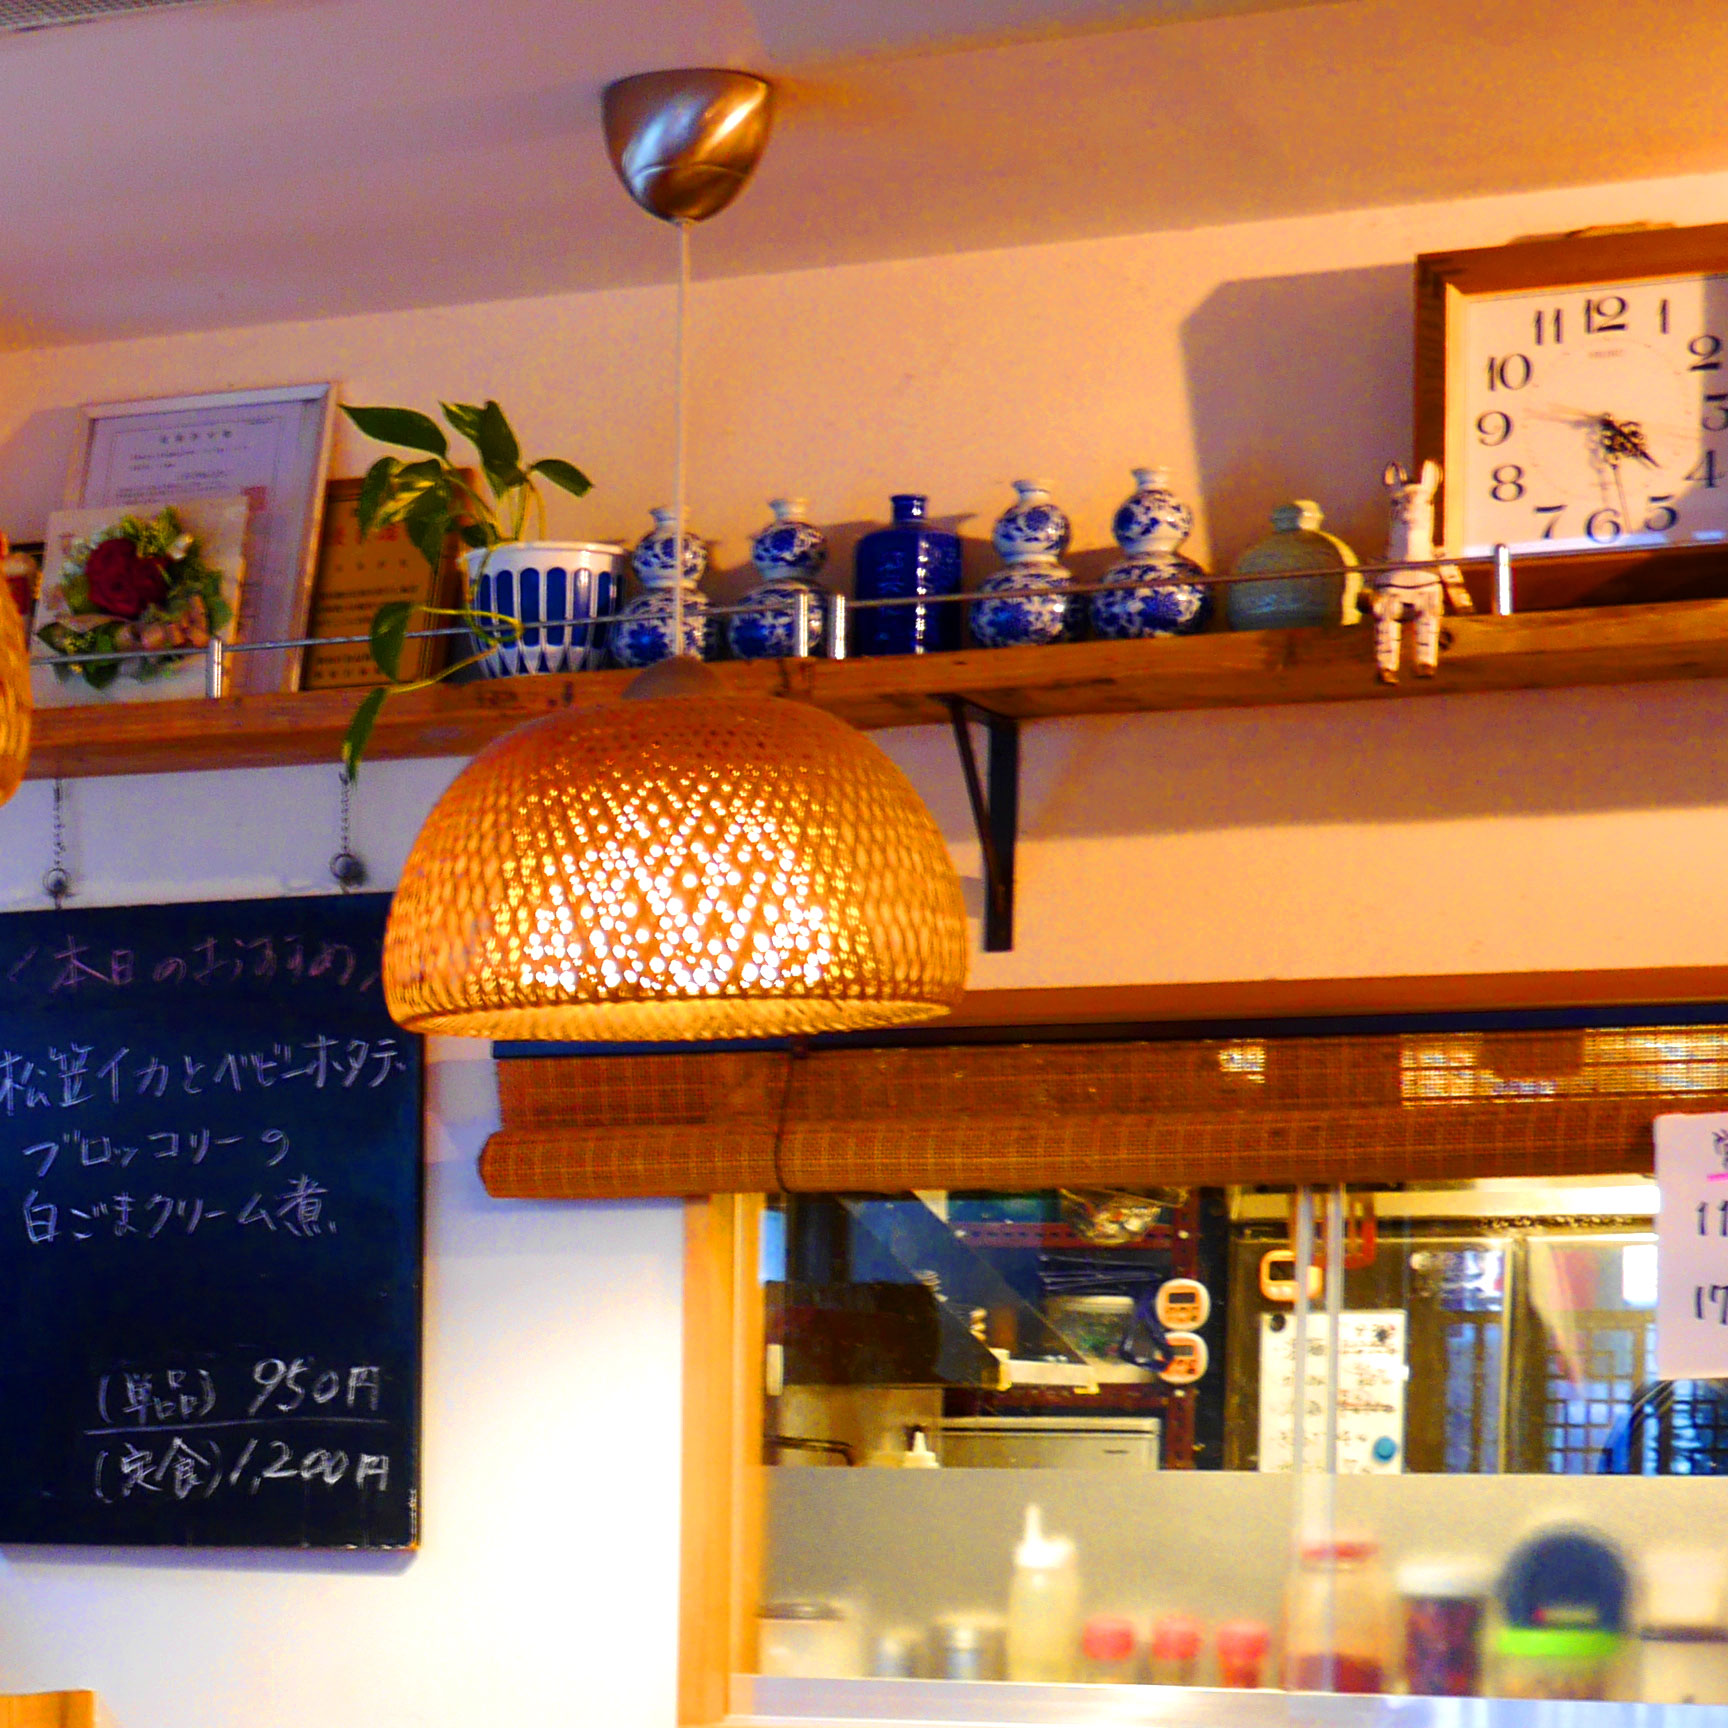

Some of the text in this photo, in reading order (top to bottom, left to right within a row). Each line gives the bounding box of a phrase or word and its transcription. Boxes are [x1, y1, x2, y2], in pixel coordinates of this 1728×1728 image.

[1534, 308, 1564, 346] 11
[1584, 296, 1628, 335] 12
[1659, 299, 1670, 335] 1
[1487, 352, 1532, 392] 10
[1687, 334, 1722, 372] 2
[1477, 411, 1512, 447] 9
[1702, 393, 1728, 432] 3
[1491, 464, 1526, 502] 8
[1685, 449, 1724, 489] 4
[1534, 505, 1568, 540] 7
[1585, 508, 1621, 545] 6
[1644, 495, 1679, 533] 5
